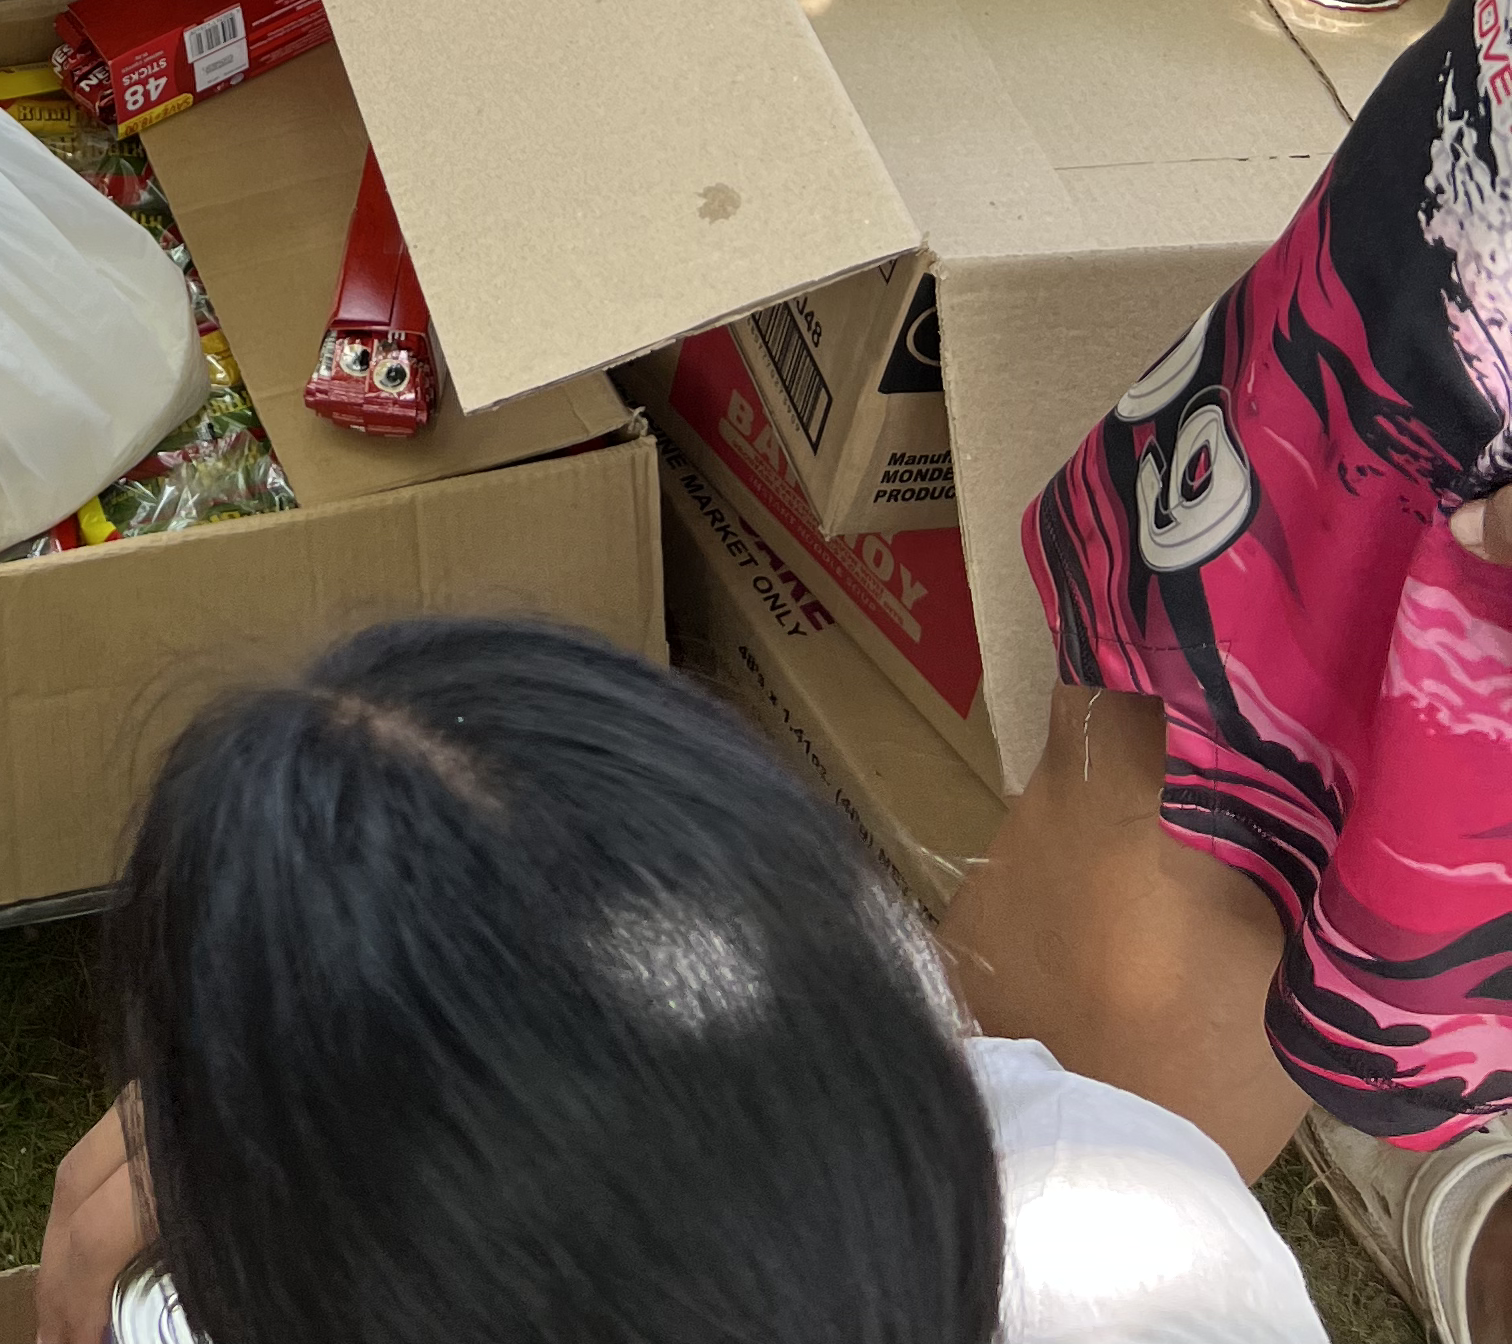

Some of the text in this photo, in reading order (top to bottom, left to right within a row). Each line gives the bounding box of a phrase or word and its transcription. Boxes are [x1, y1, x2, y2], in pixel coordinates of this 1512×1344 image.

[121, 58, 168, 86] STICKS
[124, 75, 169, 112] 48
[727, 388, 929, 611] BAOY
[873, 485, 958, 504] PRODUC
[679, 473, 808, 638] MARKET ONLY
